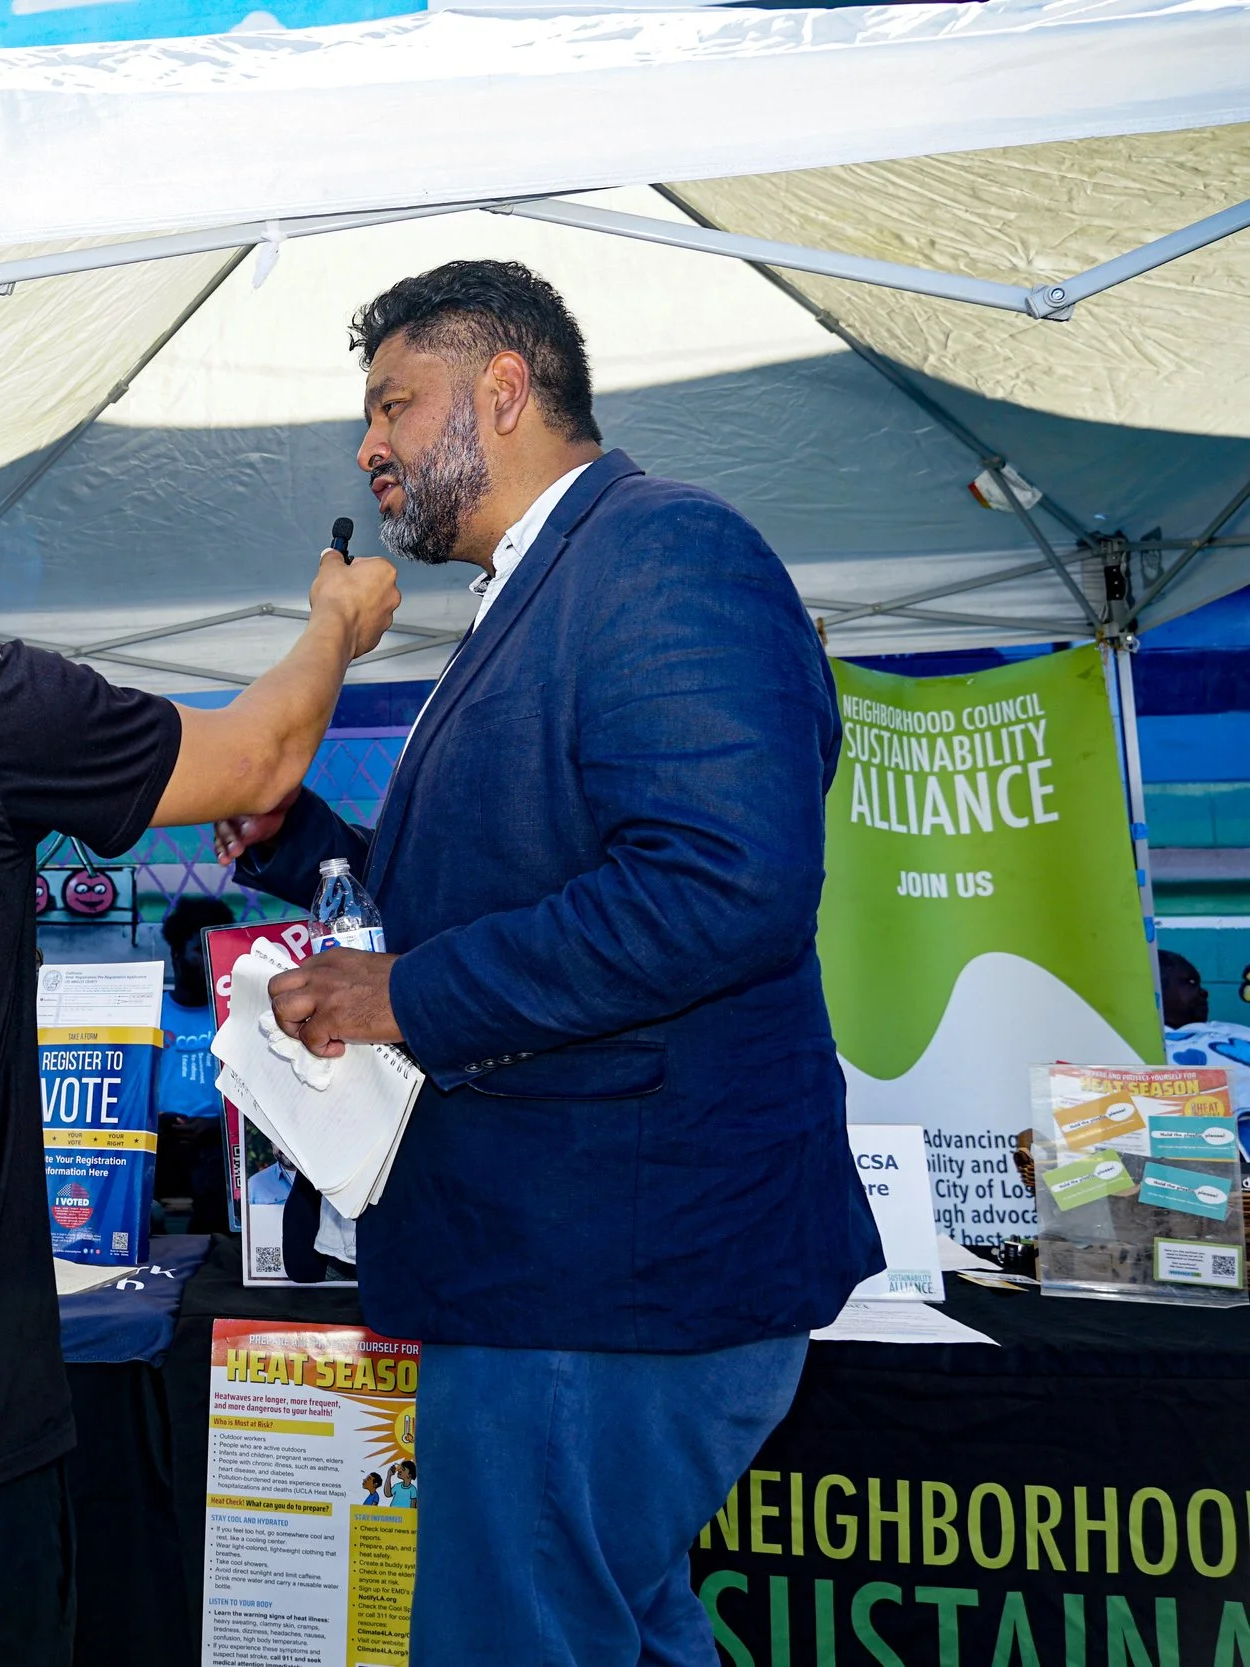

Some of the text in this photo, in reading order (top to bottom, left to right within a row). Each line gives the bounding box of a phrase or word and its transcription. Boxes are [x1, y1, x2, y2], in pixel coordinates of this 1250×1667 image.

[843, 692, 1045, 734] NEIGHBORHOOD COUNCIL
[844, 718, 1047, 772] SUSTAINABILITY
[850, 758, 1060, 836] ALLIANCE
[897, 870, 994, 898] JOIN US
[42, 1051, 123, 1070] REGISTER TO
[1128, 1079, 1200, 1096] SEASON
[40, 1077, 121, 1124] VOTE
[924, 1129, 1018, 1153] Advancing
[56, 1155, 74, 1163] Your
[76, 1156, 127, 1166] Registration
[856, 1154, 899, 1170] CSA
[971, 1155, 1008, 1174] and
[936, 1179, 1035, 1204] City of Los
[934, 1204, 1038, 1228] ugh advoca
[962, 1229, 1002, 1246] best
[890, 1282, 933, 1294] ALLIANCE
[355, 1341, 399, 1354] YOURSELF
[402, 1344, 418, 1354] FOR
[227, 1348, 418, 1393] HEAT SEASO
[214, 1392, 251, 1401] Heatwaves
[265, 1395, 288, 1405] longer,
[310, 1398, 340, 1409] frequent,
[246, 1404, 281, 1413] dangerous
[309, 1408, 333, 1416] health!
[218, 1474, 270, 1483] Pollution-burdened
[218, 1482, 260, 1490] hospitalizations
[258, 1518, 288, 1526] HYDRATED
[700, 1469, 1250, 1578] NEIGHBORHOO
[358, 1594, 397, 1603] NotifyLA.org
